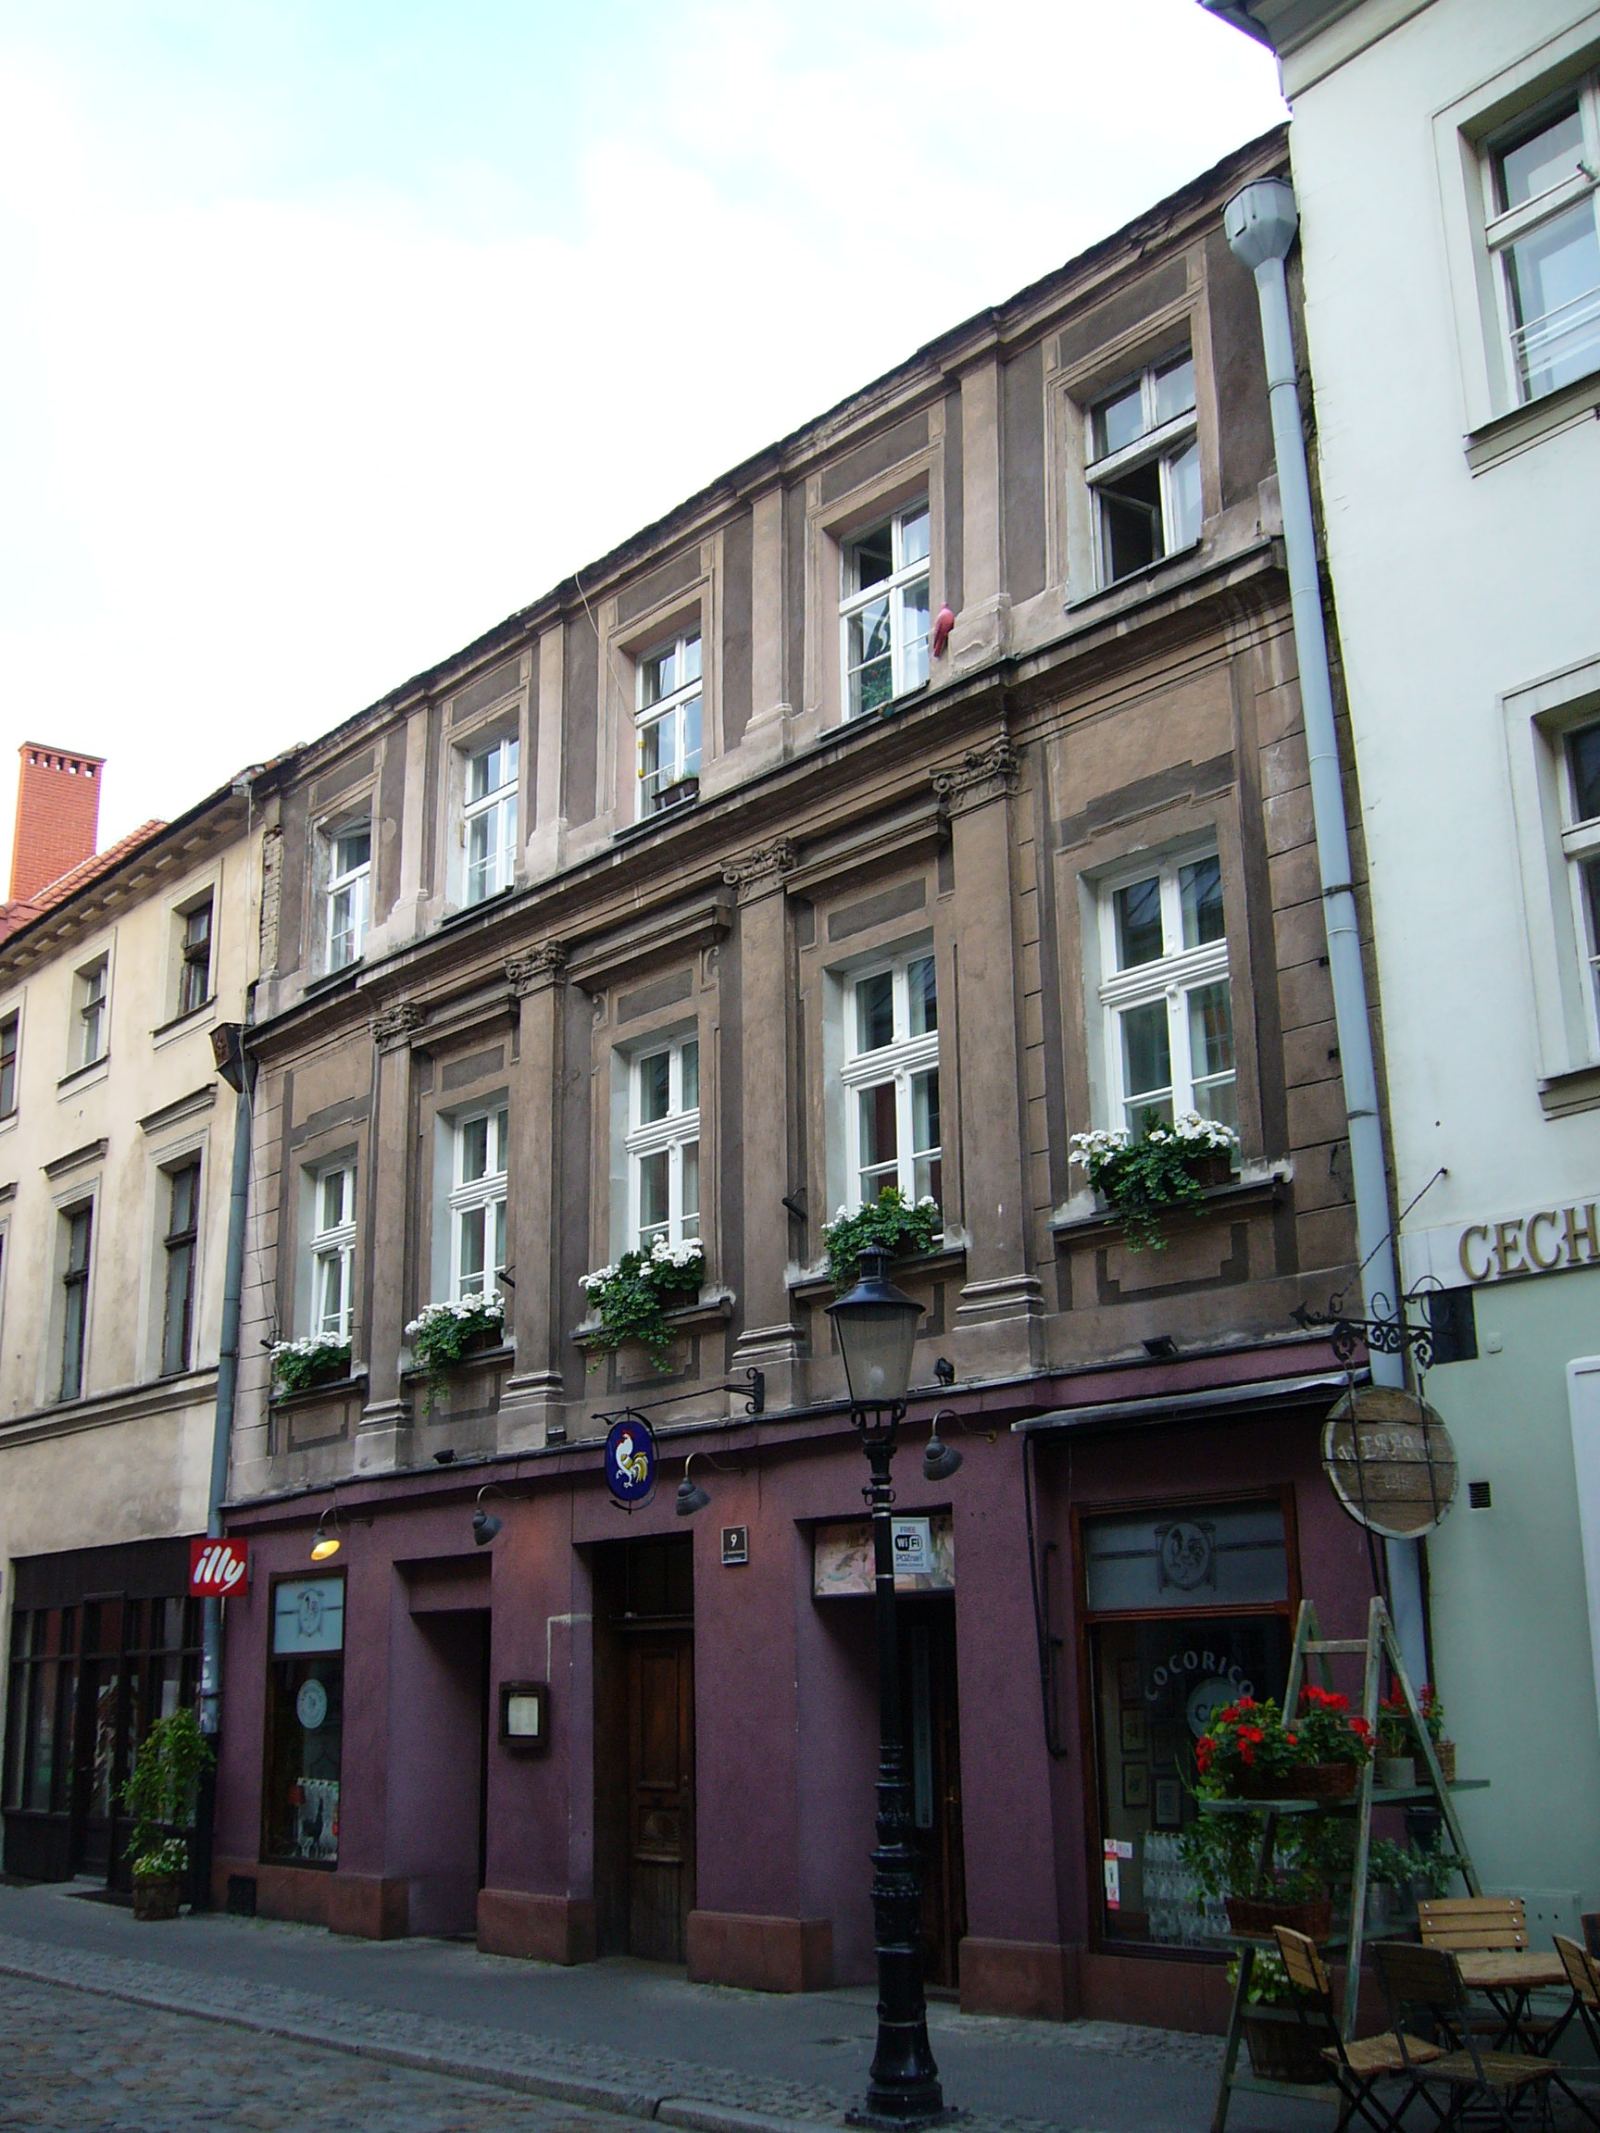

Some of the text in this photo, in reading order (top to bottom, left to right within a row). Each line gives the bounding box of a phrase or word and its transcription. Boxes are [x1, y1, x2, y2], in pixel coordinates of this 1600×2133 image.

[1459, 1203, 1600, 1281] CECH
[731, 1534, 738, 1548] 9
[193, 1544, 247, 1593] illy
[1144, 1650, 1255, 1701] COCORICO
